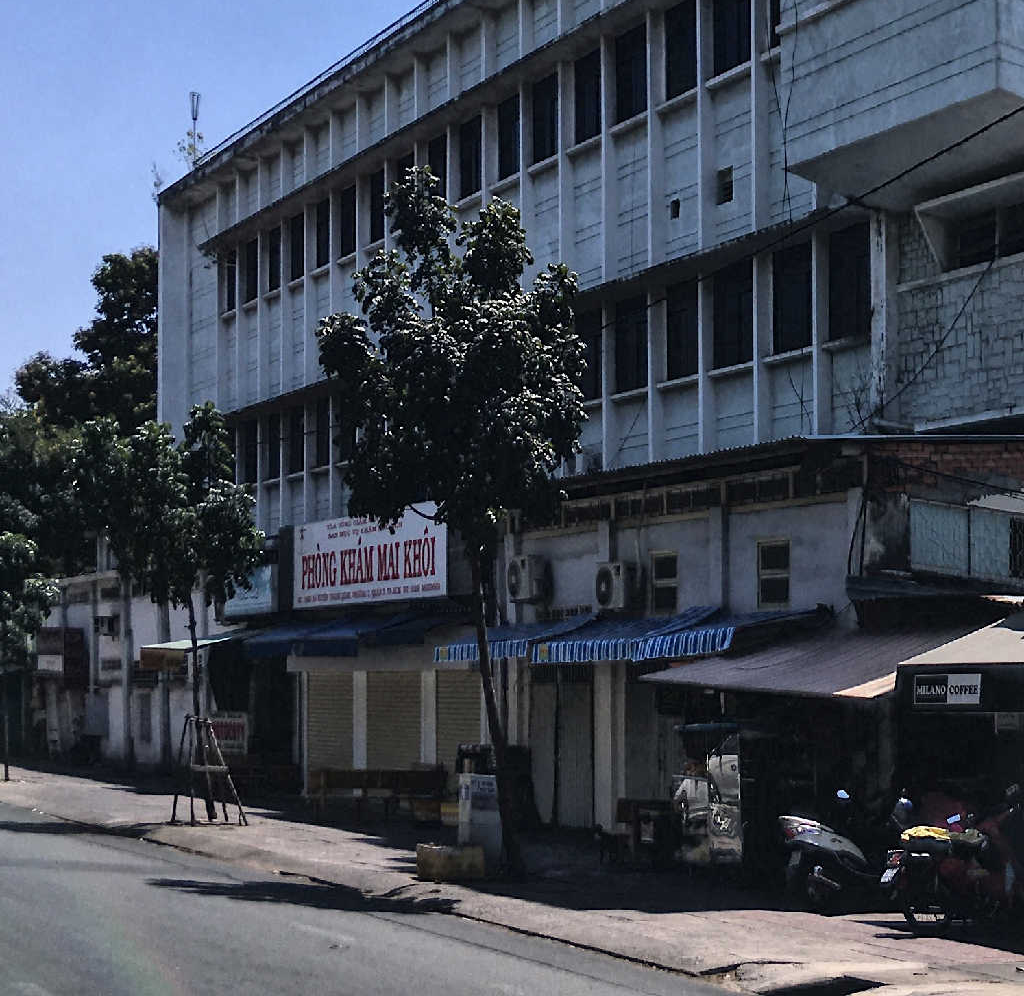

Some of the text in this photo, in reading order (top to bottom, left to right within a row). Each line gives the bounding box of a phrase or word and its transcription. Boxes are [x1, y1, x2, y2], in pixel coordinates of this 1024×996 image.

[302, 543, 337, 591] PHÒNG
[340, 536, 374, 586] KHÁM
[377, 542, 400, 582] MAI
[916, 684, 979, 696] MILANO COFFEE
